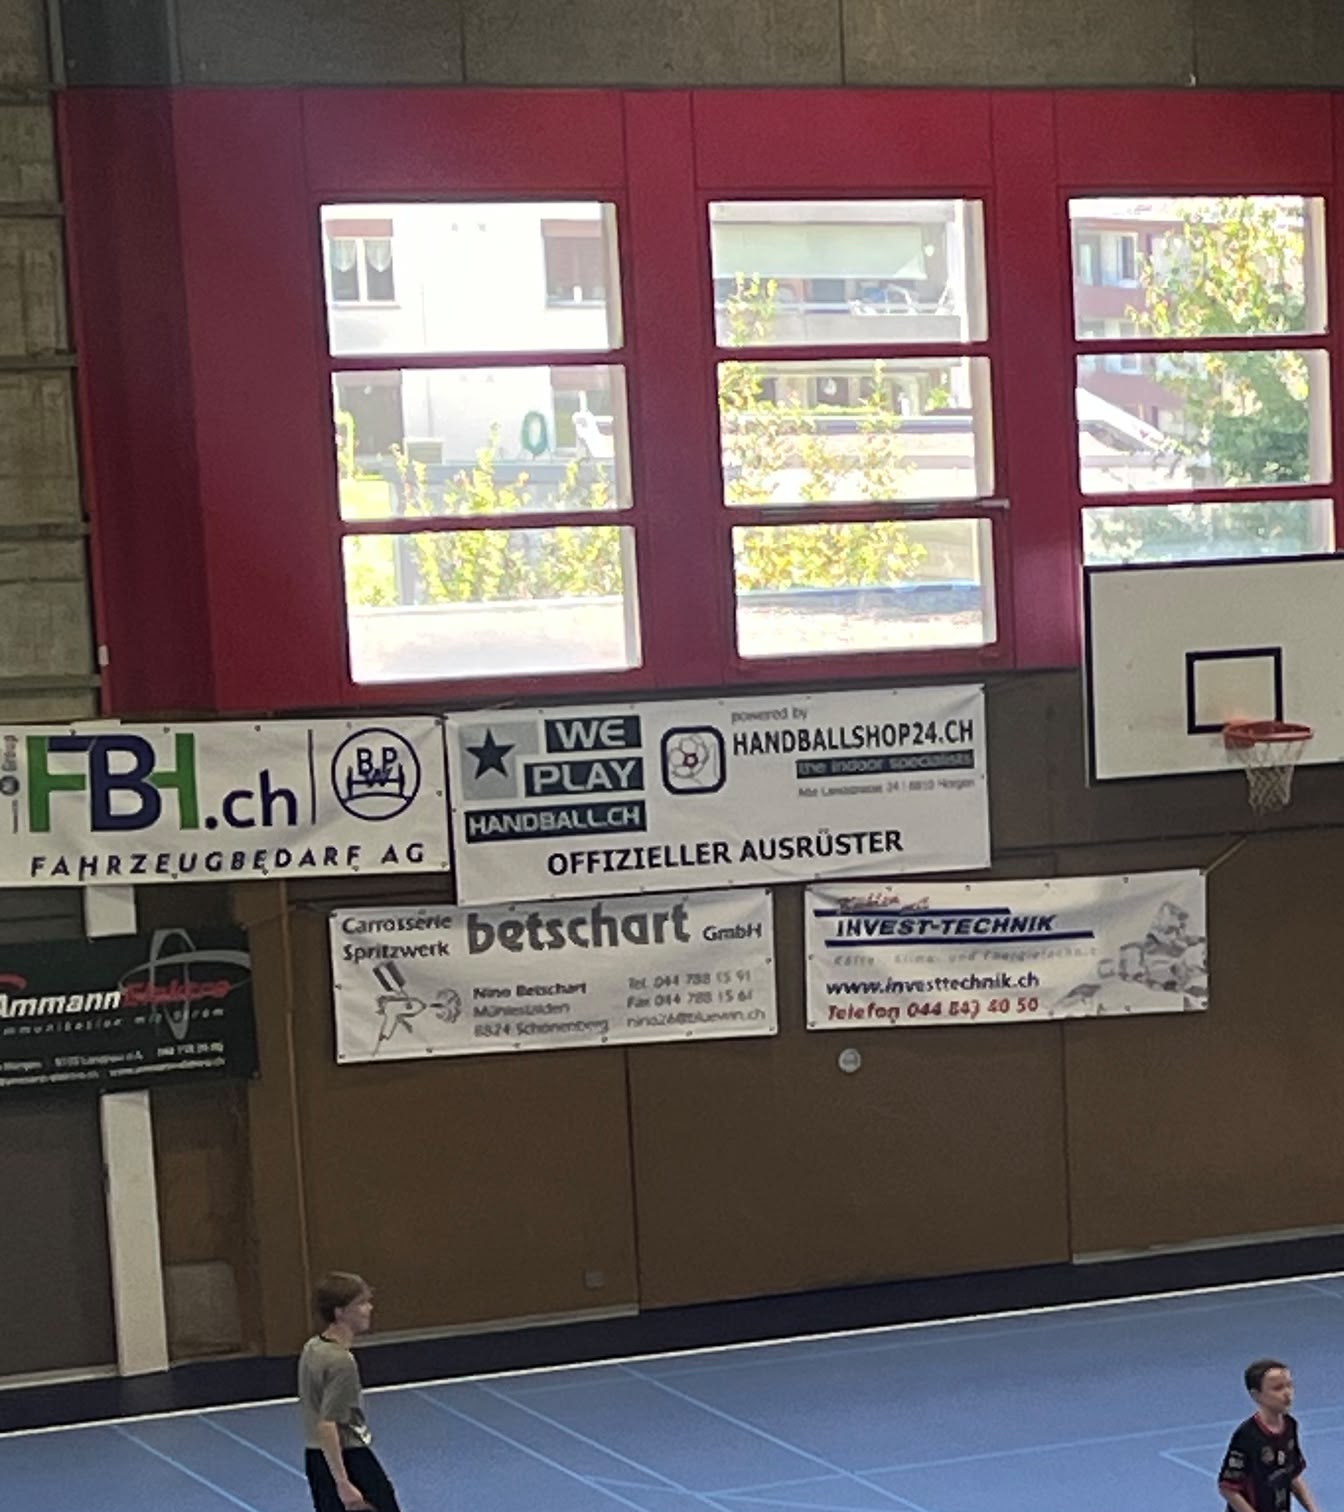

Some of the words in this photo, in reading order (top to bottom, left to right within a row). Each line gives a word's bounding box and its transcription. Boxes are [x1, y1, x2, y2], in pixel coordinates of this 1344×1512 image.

[555, 719, 626, 750] WE
[732, 719, 975, 756] HANDBALLSHOP24.CH
[26, 732, 298, 833] FBH.ch
[533, 759, 637, 793] PLAY
[468, 806, 640, 836] HANDBALL.CH
[30, 845, 362, 881] FAHRZEUGBEDARF
[381, 842, 424, 864] AG
[547, 840, 732, 877] OFFIZIELLER
[739, 827, 904, 863] AUSRÜSTER
[342, 914, 453, 935] Carrosserie
[467, 902, 691, 955] betschart
[836, 914, 1057, 937] INVEST-TECHNIK
[343, 941, 450, 964] Spritzwerk
[826, 971, 1040, 996] www.investtechnik.ch
[828, 1003, 901, 1021] Telefon
[906, 1001, 942, 1018] 044
[1016, 996, 1039, 1013] 50
